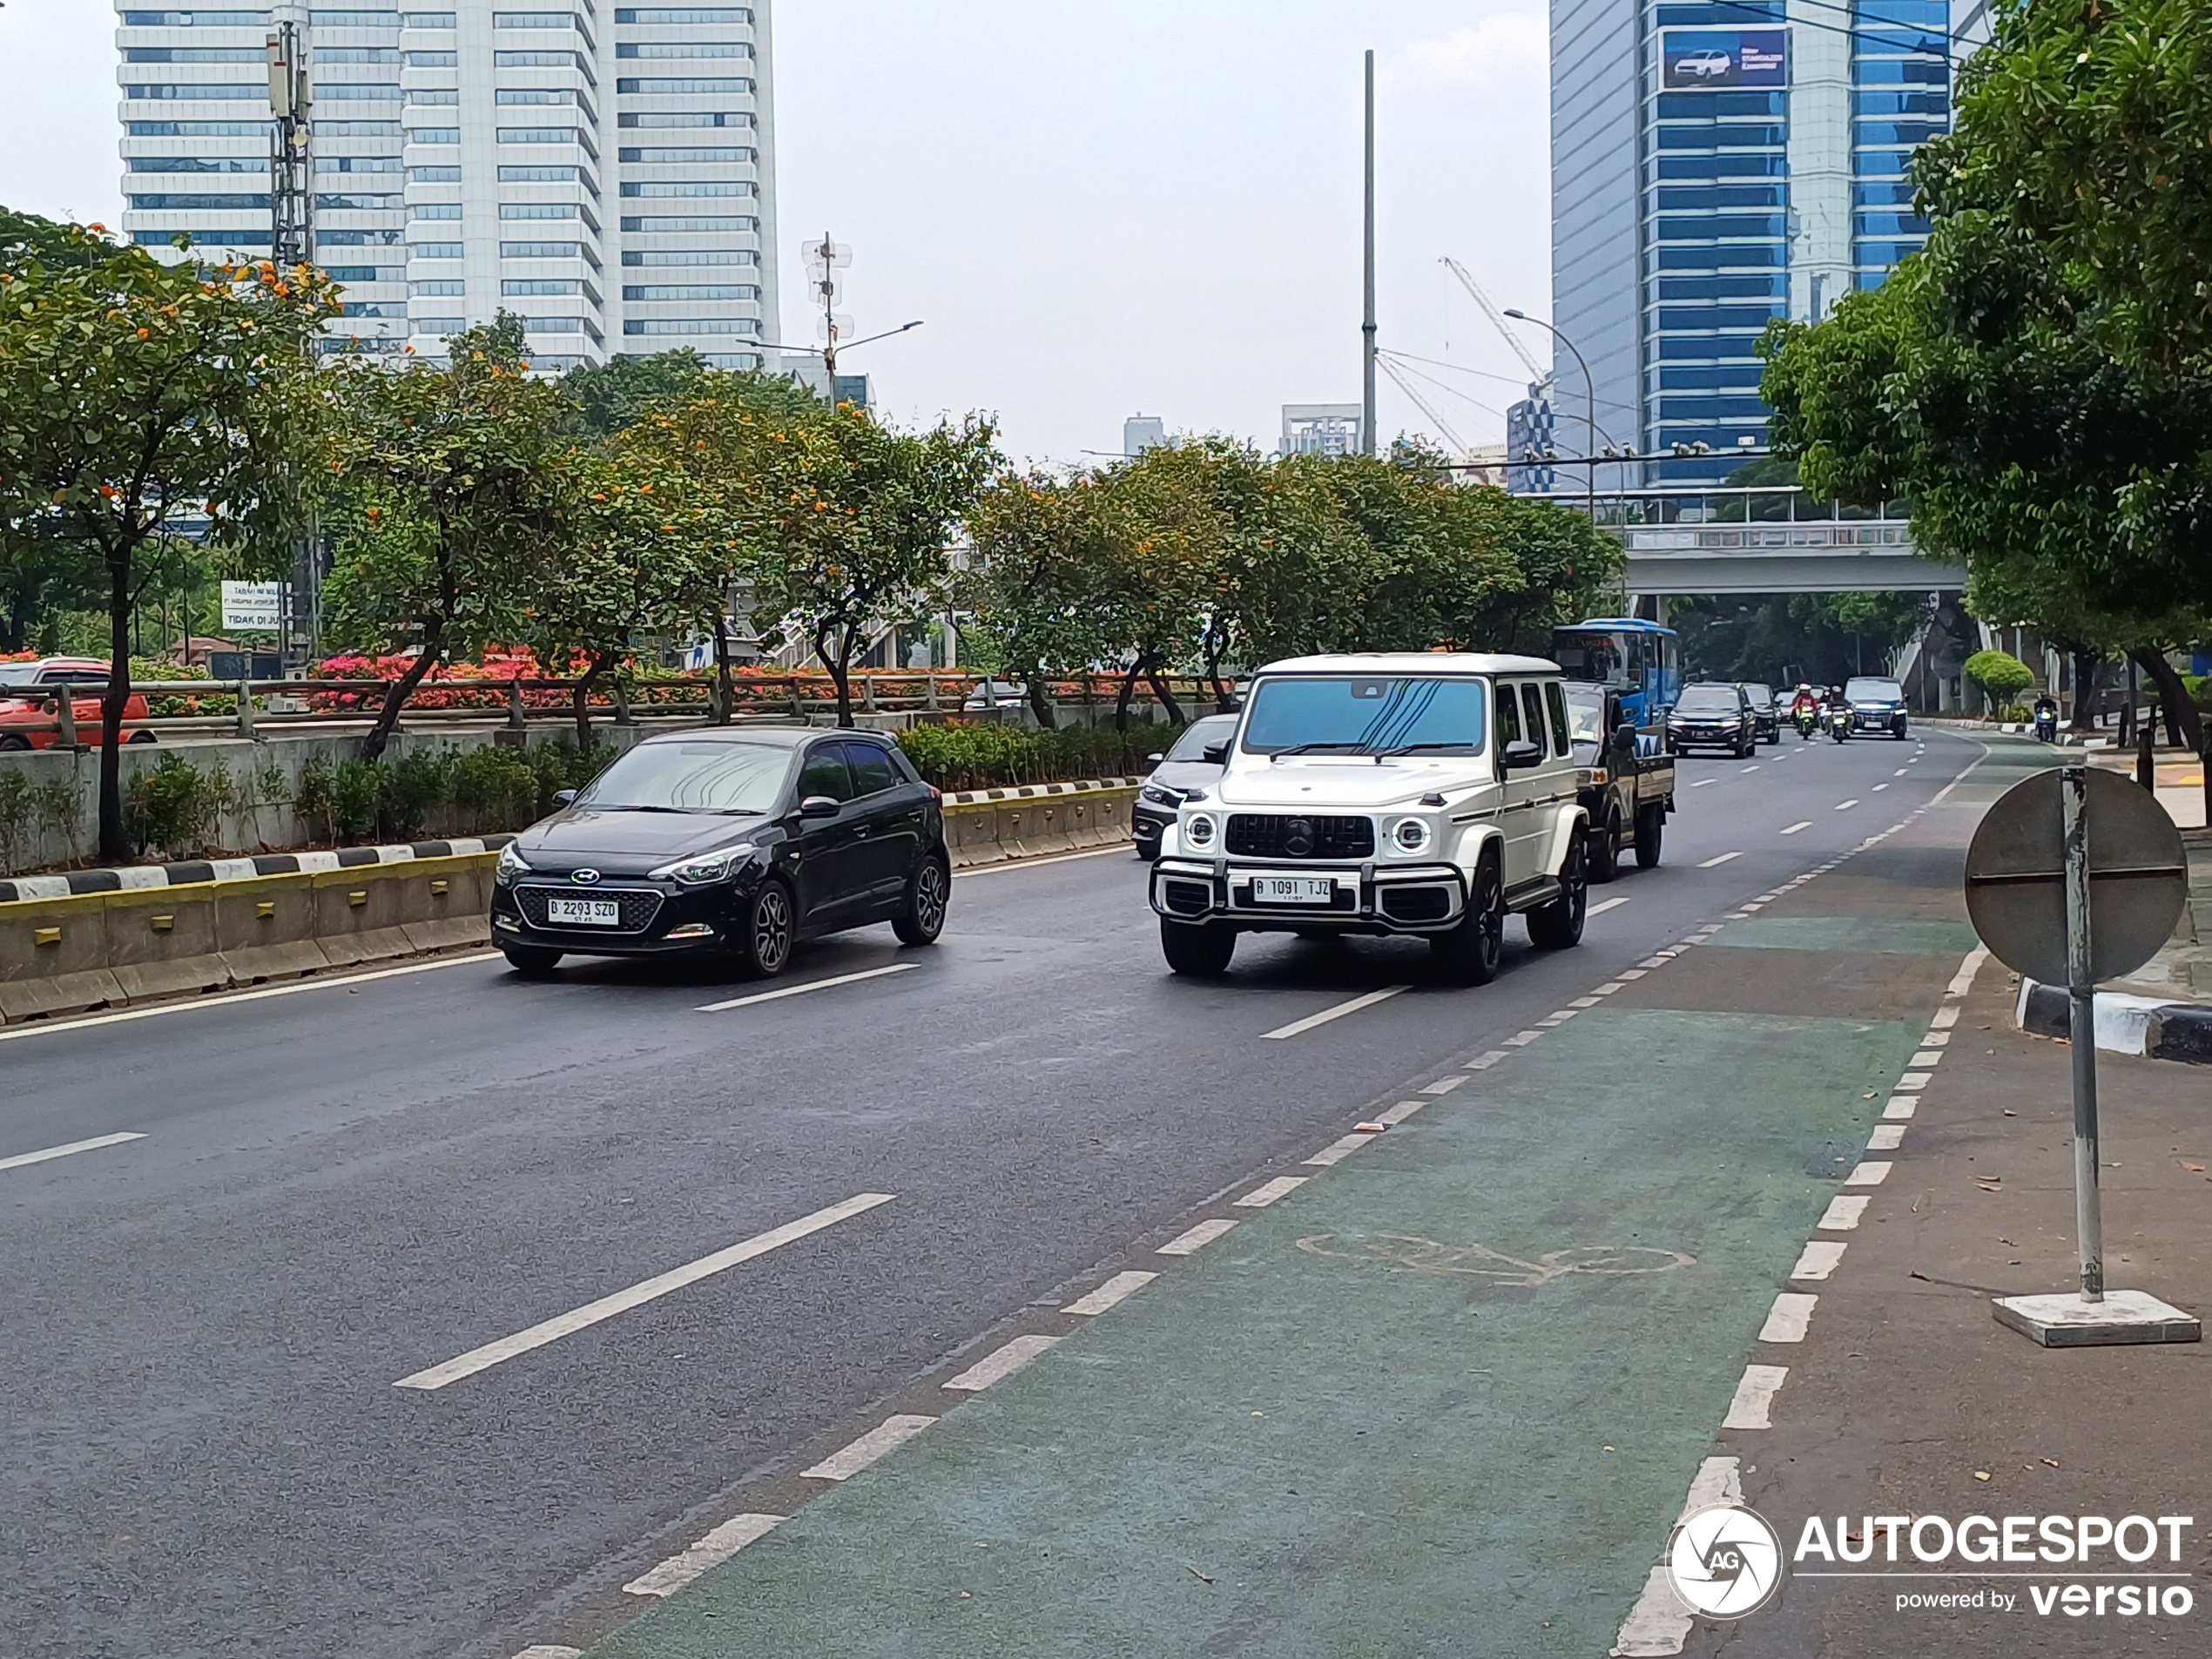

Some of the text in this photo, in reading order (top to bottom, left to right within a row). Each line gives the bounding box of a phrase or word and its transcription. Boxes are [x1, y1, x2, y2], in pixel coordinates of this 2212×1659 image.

[227, 615, 279, 624] TIDAK DI JU
[1257, 880, 1329, 894] B 1091 TJZ
[551, 900, 558, 914] B
[563, 901, 590, 915] 2293
